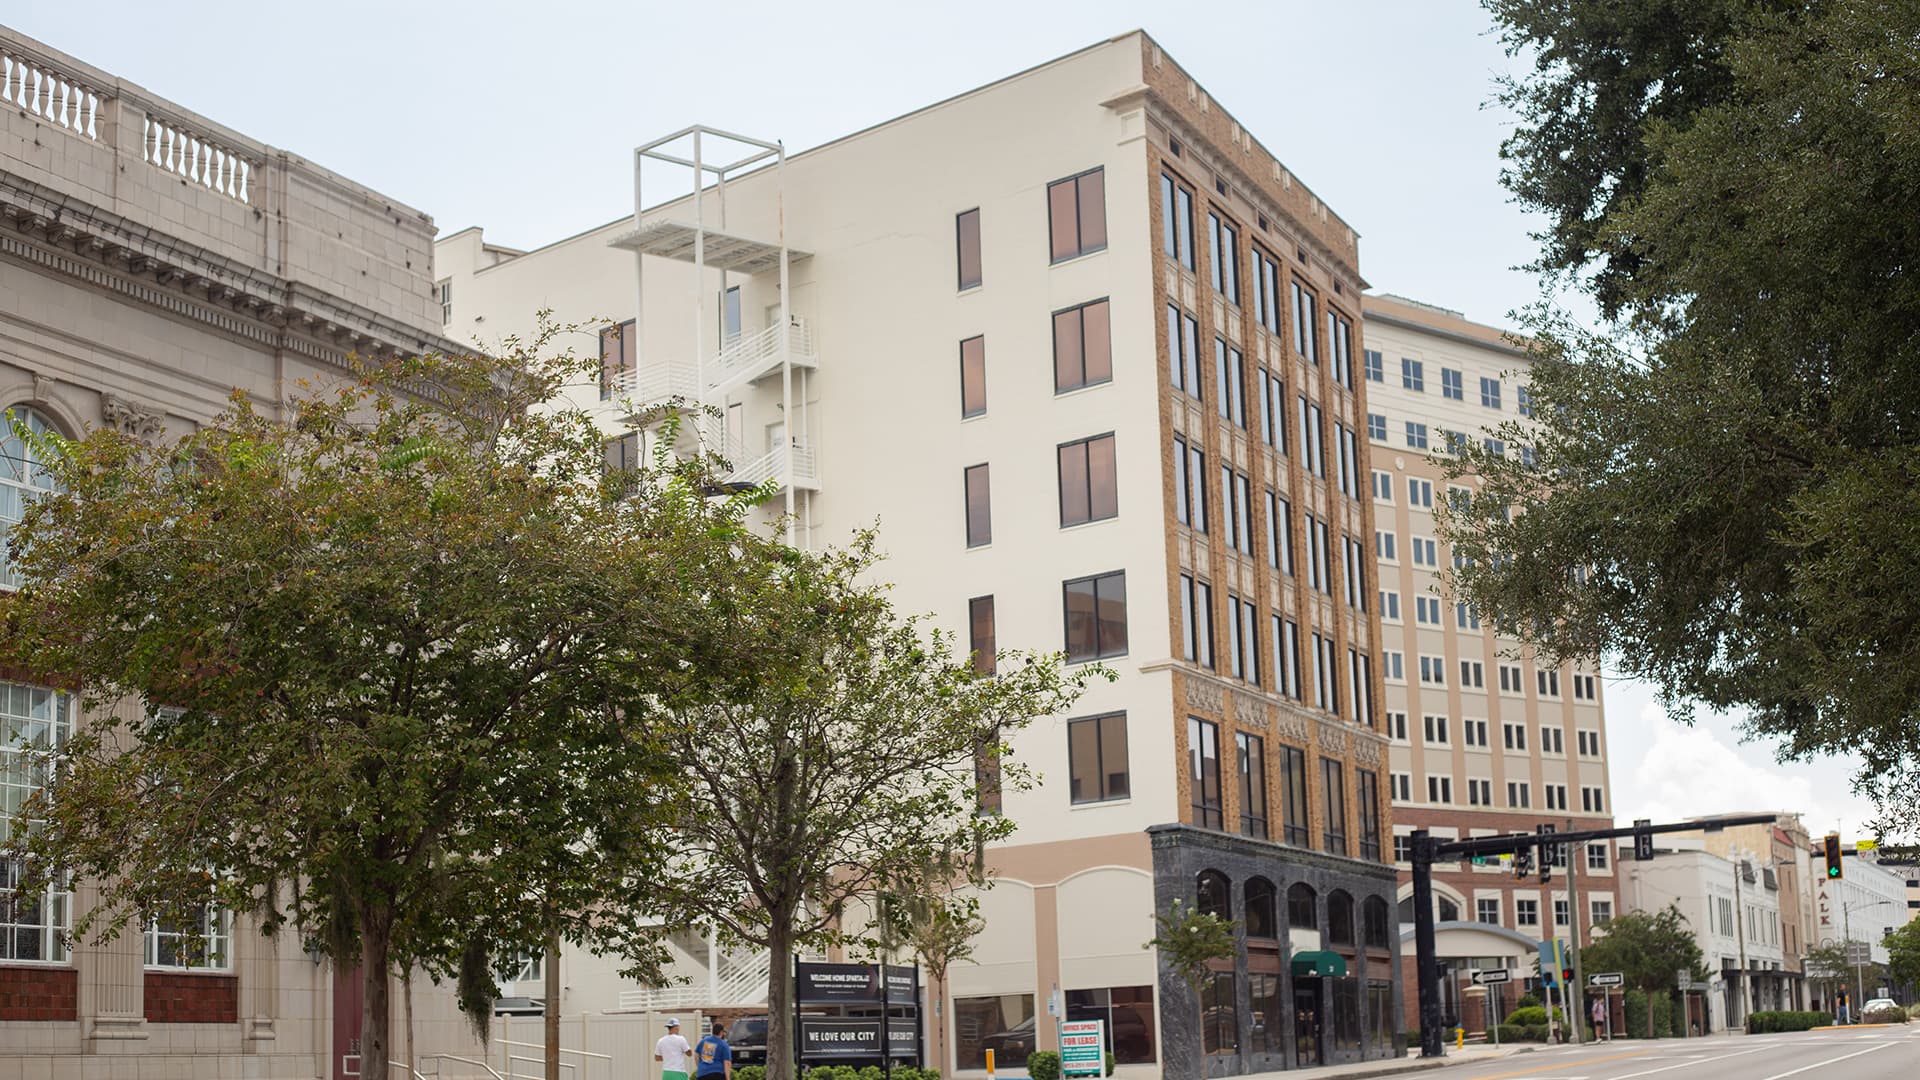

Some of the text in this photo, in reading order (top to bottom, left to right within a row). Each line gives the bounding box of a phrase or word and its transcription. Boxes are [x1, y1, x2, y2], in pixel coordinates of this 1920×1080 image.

[809, 1031, 876, 1041] WE LOVE OUR CITY
[1064, 1036, 1096, 1045] FOR LEASE
